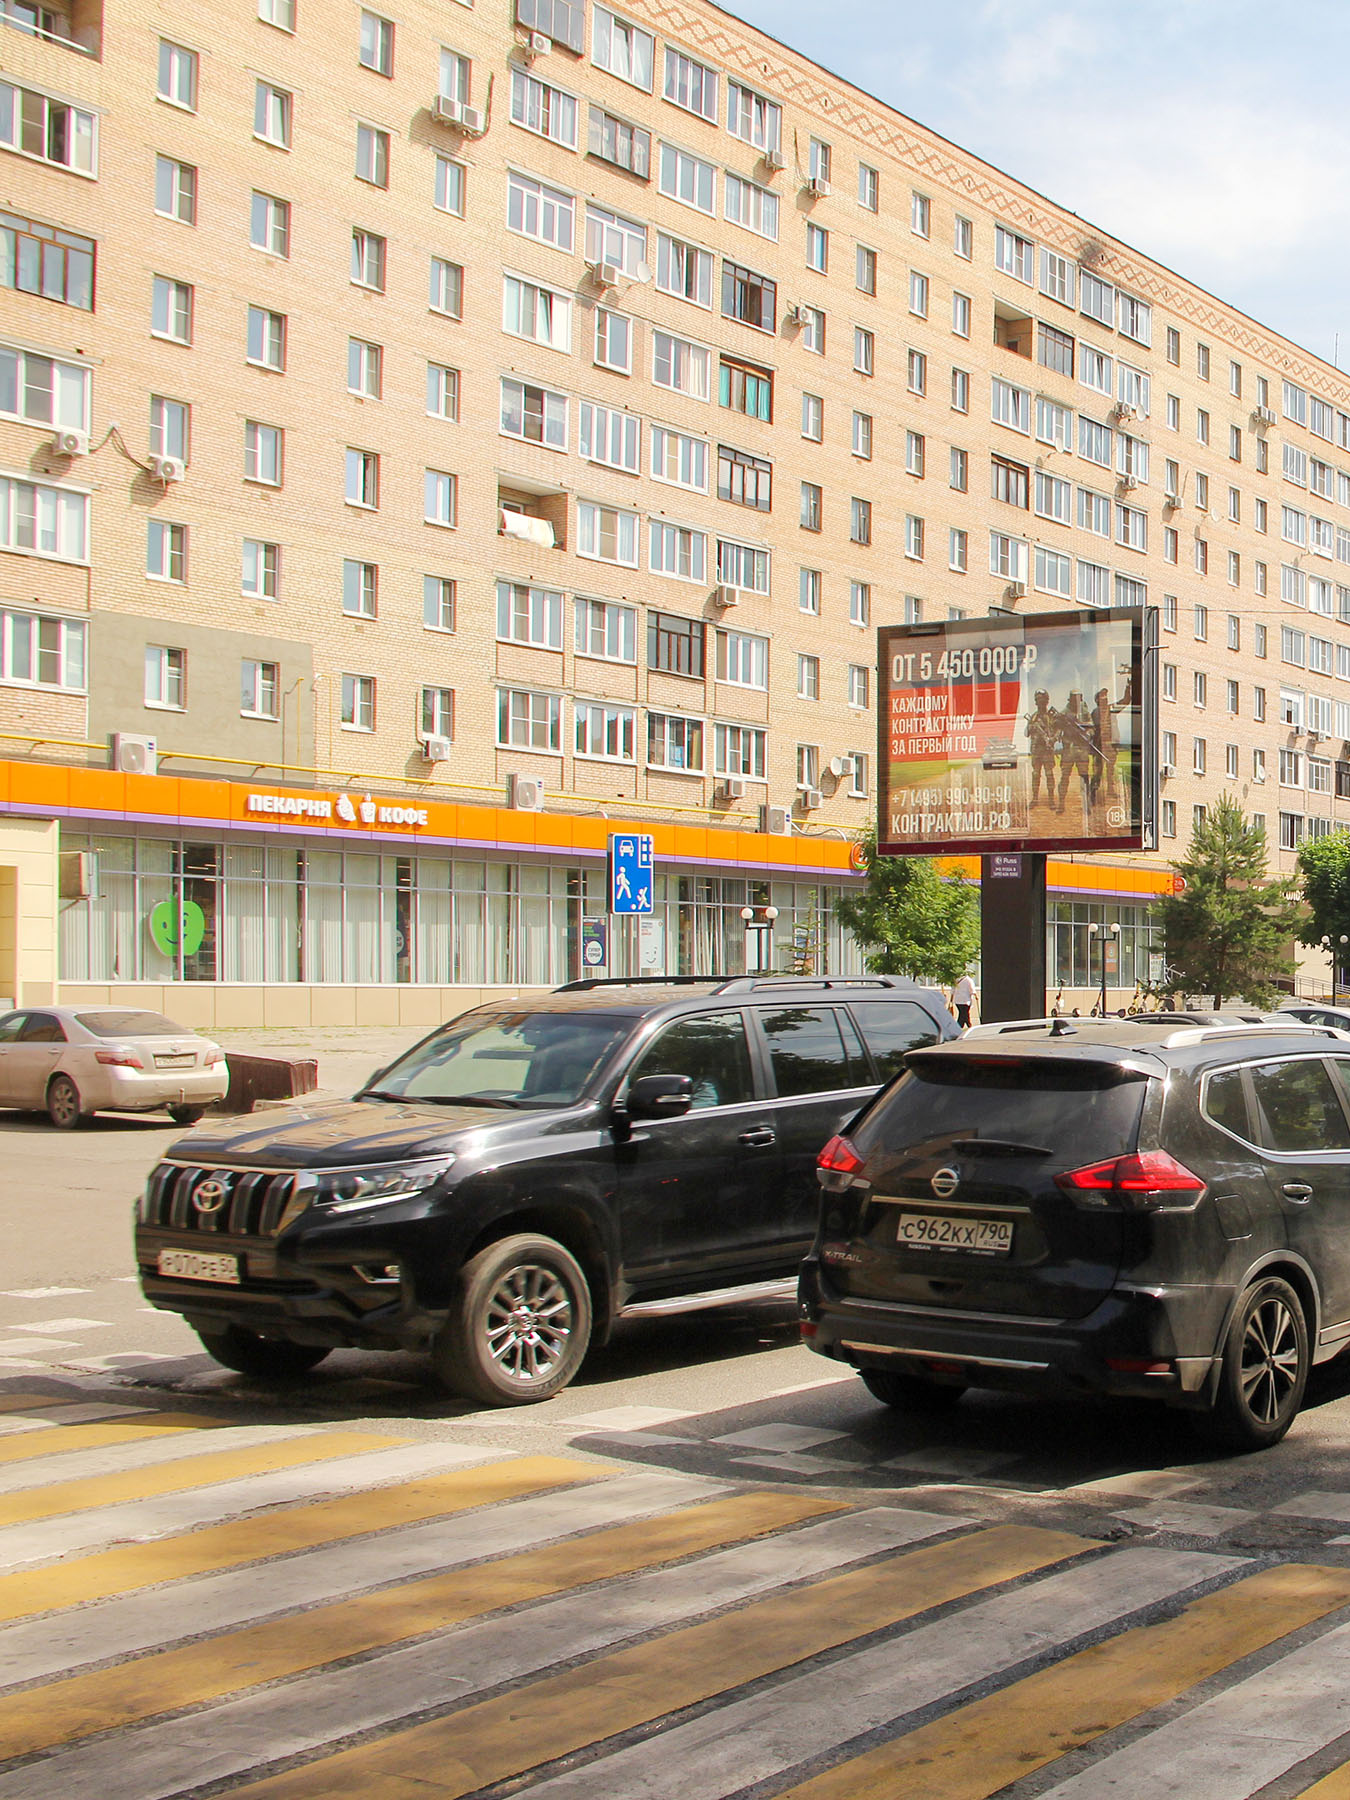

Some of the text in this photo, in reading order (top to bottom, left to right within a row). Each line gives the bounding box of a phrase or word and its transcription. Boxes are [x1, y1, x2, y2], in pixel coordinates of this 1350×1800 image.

[892, 653, 916, 682] ОТ
[920, 652, 932, 680] 5
[937, 650, 974, 679] 450
[980, 646, 1017, 676] 000
[892, 695, 948, 714] КАЖДОМУ
[892, 714, 975, 735] КОНТРАКТНИКУ
[892, 734, 977, 755] ЗА ПЕРВЫЙ ГОД
[892, 790, 907, 806] +7
[248, 794, 428, 825] ПЕКАРНЯ КОФЕ
[892, 810, 1011, 834] КОНТРАКТМО.РФ
[980, 1223, 1008, 1240] 790
